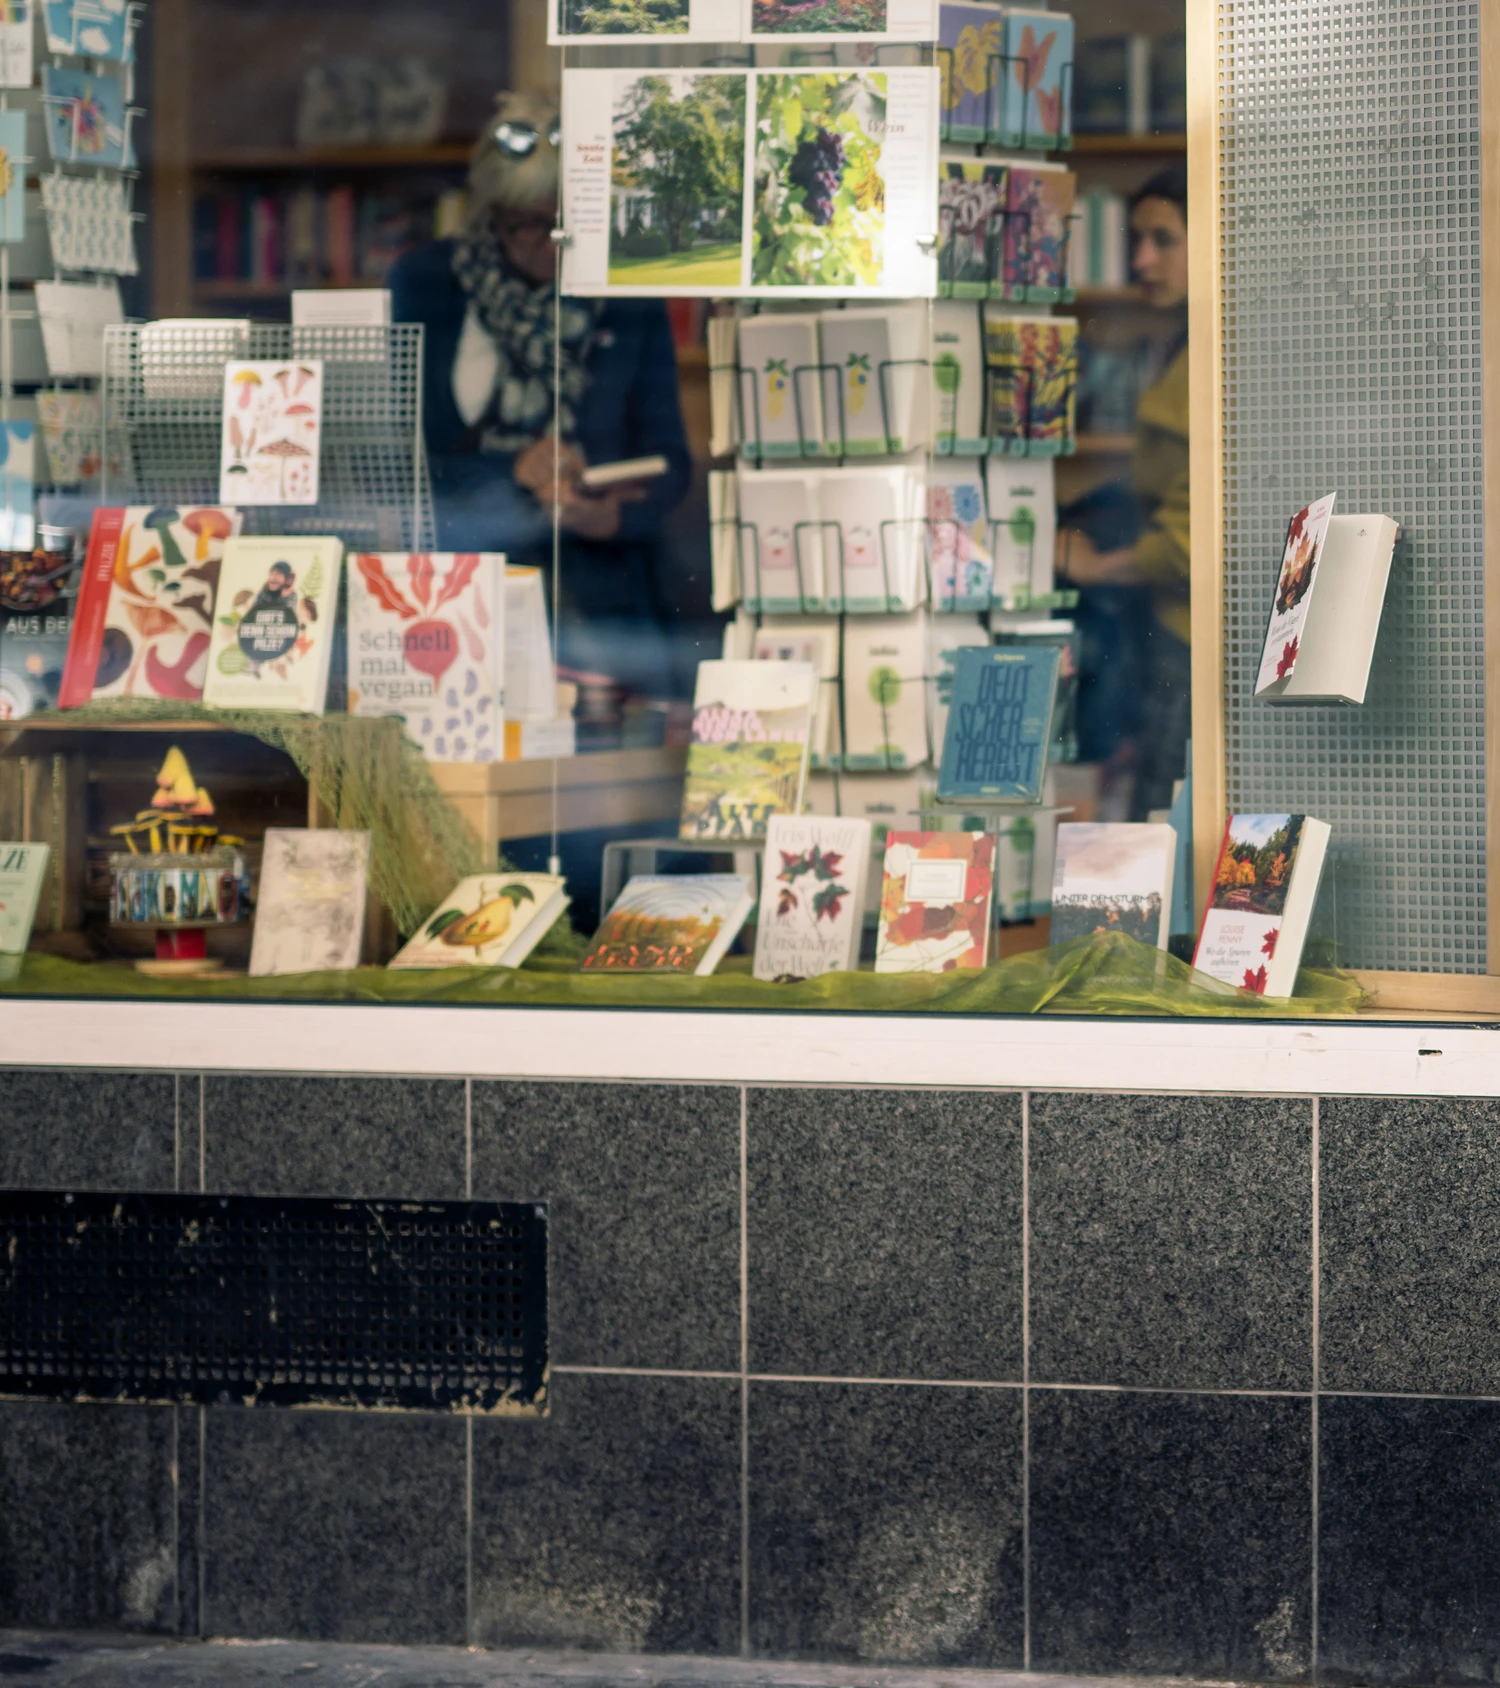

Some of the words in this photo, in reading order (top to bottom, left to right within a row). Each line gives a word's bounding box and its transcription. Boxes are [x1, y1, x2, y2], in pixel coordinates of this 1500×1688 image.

[5, 615, 40, 634] AUS
[360, 654, 407, 676] mal
[360, 680, 433, 701] vegan
[1055, 894, 1088, 904] UNTER
[1090, 894, 1113, 903] DEM
[1220, 924, 1246, 935] LOUISE
[1218, 935, 1243, 944] PENNY
[1205, 947, 1214, 956] Wo
[1215, 947, 1227, 956] die
[1228, 946, 1252, 958] Spuren
